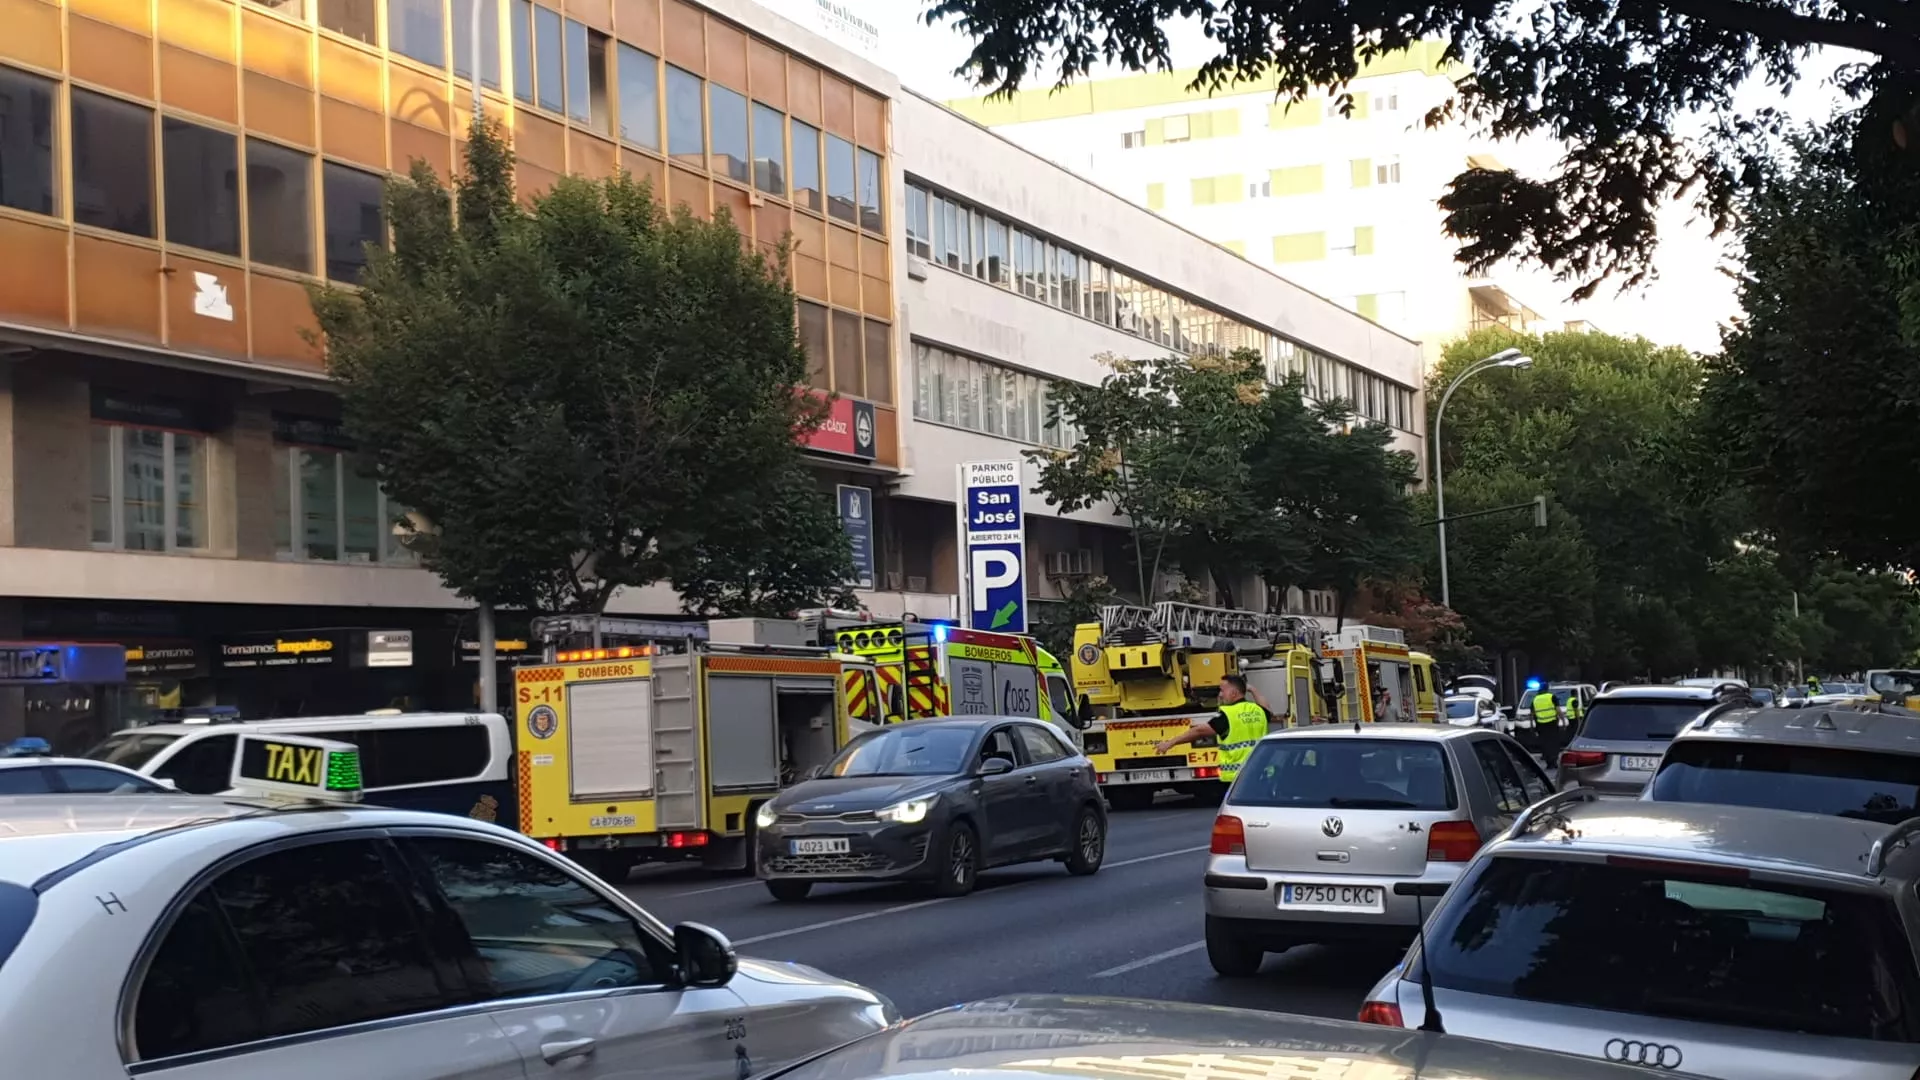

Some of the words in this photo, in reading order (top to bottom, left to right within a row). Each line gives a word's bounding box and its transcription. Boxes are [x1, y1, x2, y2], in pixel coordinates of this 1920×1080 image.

[827, 417, 848, 435] CÁDIZ
[971, 462, 1014, 473] PARKING
[972, 473, 1014, 485] PÚBLICO
[977, 491, 1011, 504] San
[974, 509, 1016, 525] José
[970, 533, 1002, 542] ABIERTO
[1003, 532, 1012, 541] 24
[972, 549, 1020, 612] P
[221, 644, 277, 655] Tomamos
[276, 637, 333, 655] impulso
[964, 646, 1012, 661] BOMBEROS
[577, 664, 634, 678] BOMBEROS
[519, 686, 563, 703] S-11
[1010, 687, 1031, 713] 085
[1188, 751, 1219, 763] E-17
[1626, 757, 1654, 768] 6124
[265, 743, 323, 787] TAXI
[798, 839, 825, 853] 4023
[1294, 886, 1337, 903] 9750
[1341, 886, 1376, 905] CKC
[95, 891, 128, 916] H
